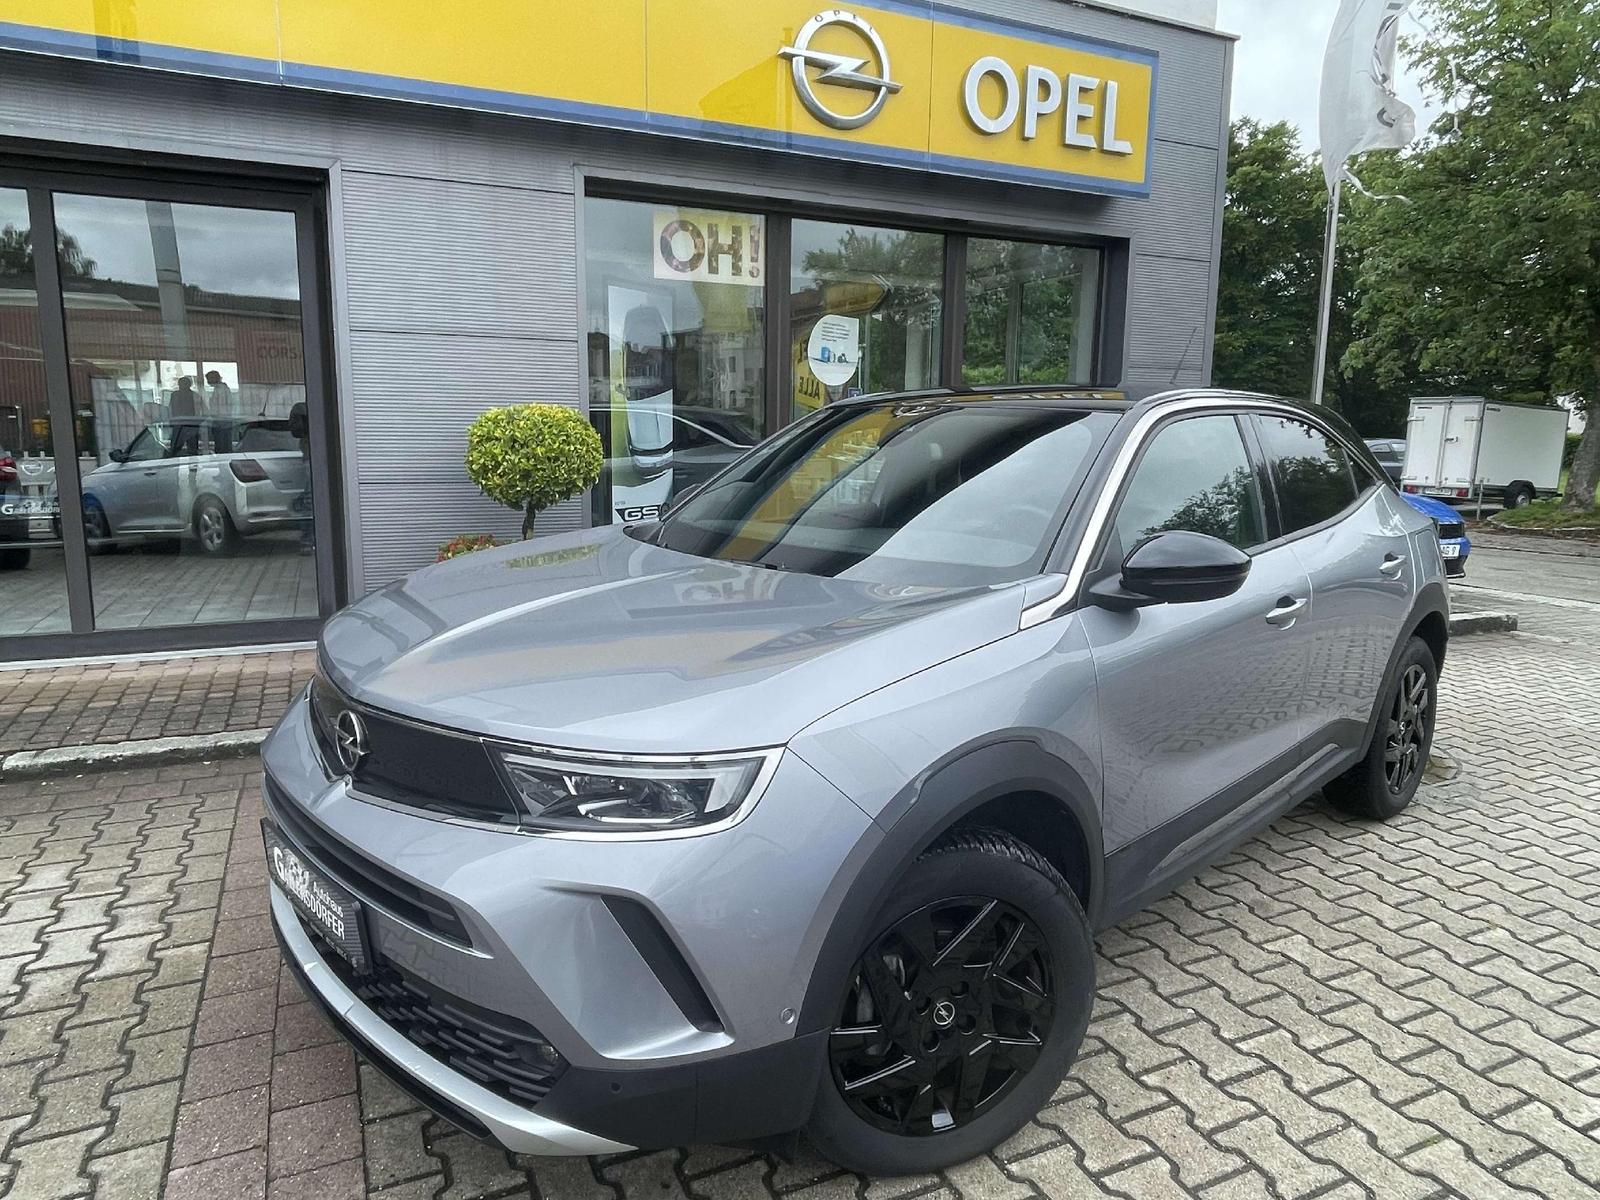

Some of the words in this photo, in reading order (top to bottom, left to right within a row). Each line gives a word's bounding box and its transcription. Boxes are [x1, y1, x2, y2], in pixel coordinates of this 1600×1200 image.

[964, 56, 1133, 155] OPEL
[660, 219, 761, 279] OH!
[313, 881, 344, 918] Autohaus
